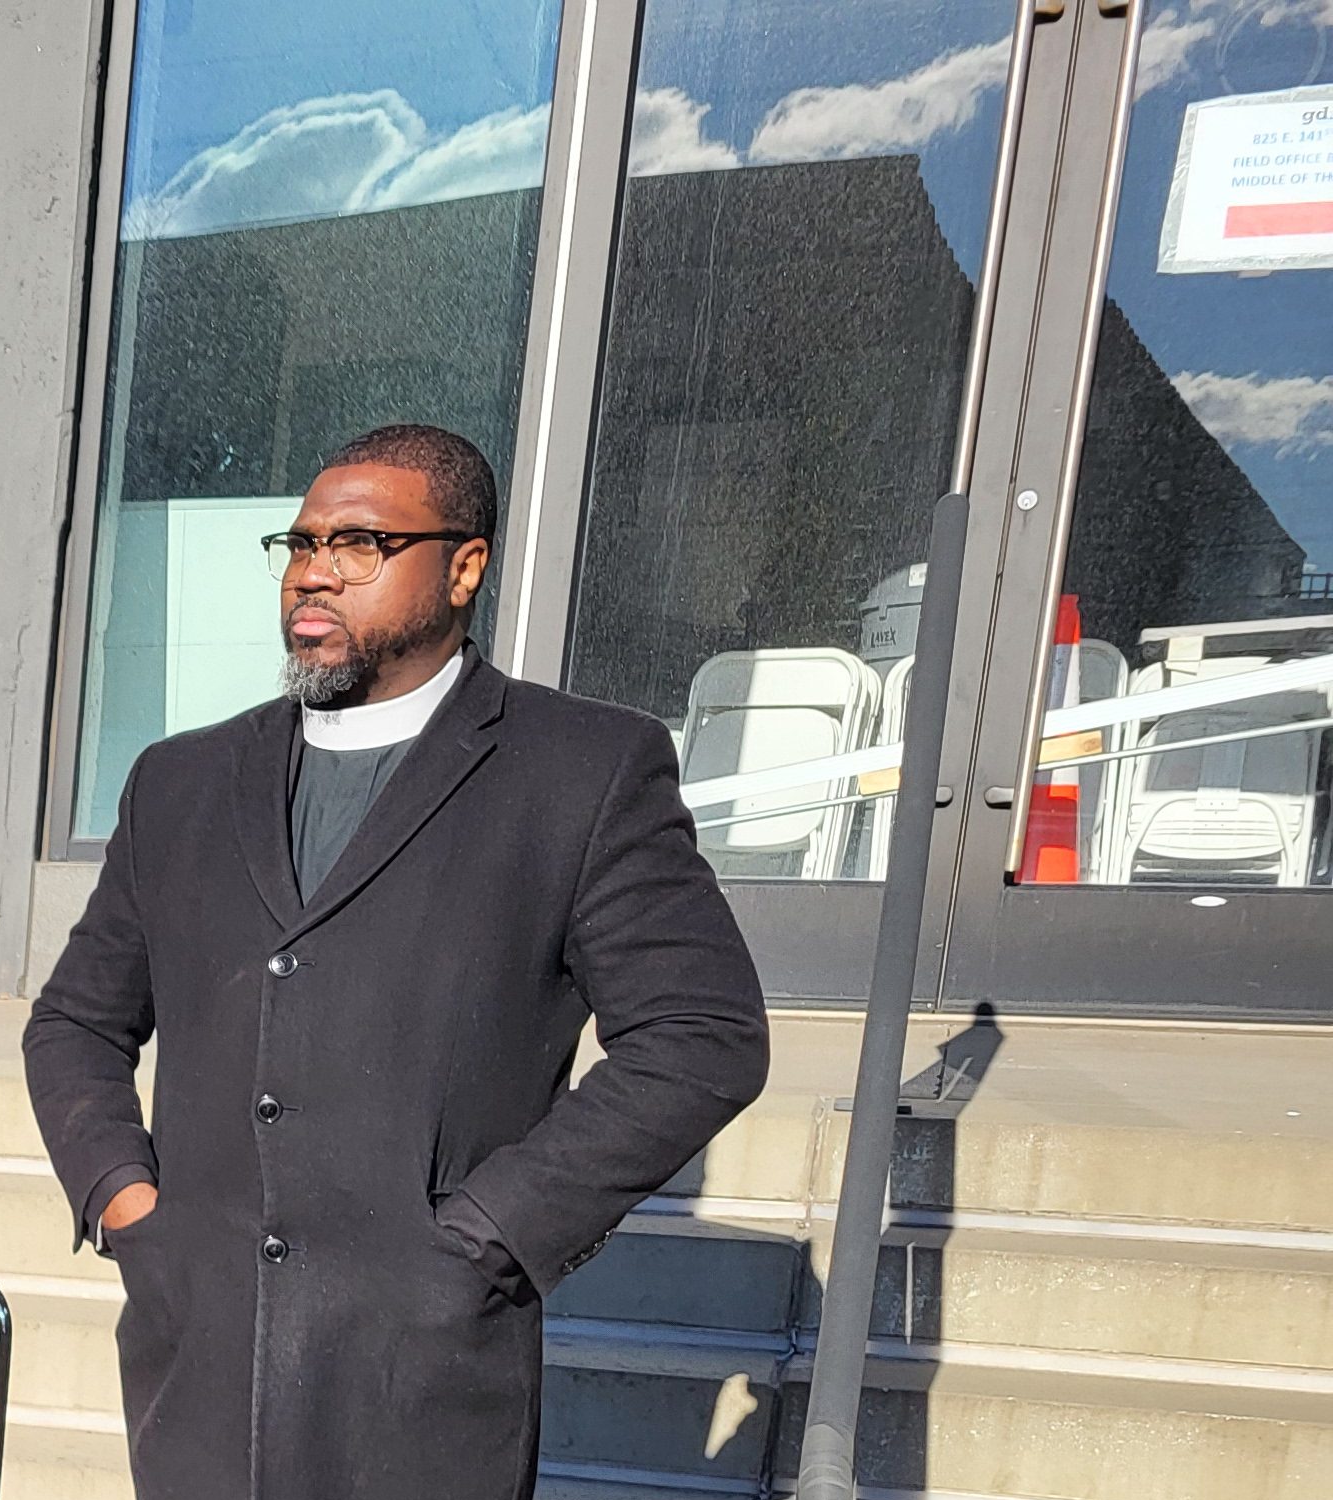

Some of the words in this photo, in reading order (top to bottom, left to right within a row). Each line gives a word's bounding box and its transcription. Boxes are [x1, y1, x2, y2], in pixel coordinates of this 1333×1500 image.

[1301, 106, 1333, 125] gd
[1253, 133, 1277, 145] 825
[1282, 132, 1294, 144] E.
[1233, 155, 1271, 168] FIELD
[1274, 152, 1323, 166] OFFICE
[1231, 174, 1286, 188] MIDDLE
[1290, 172, 1308, 185] OF
[1314, 170, 1333, 183] TH
